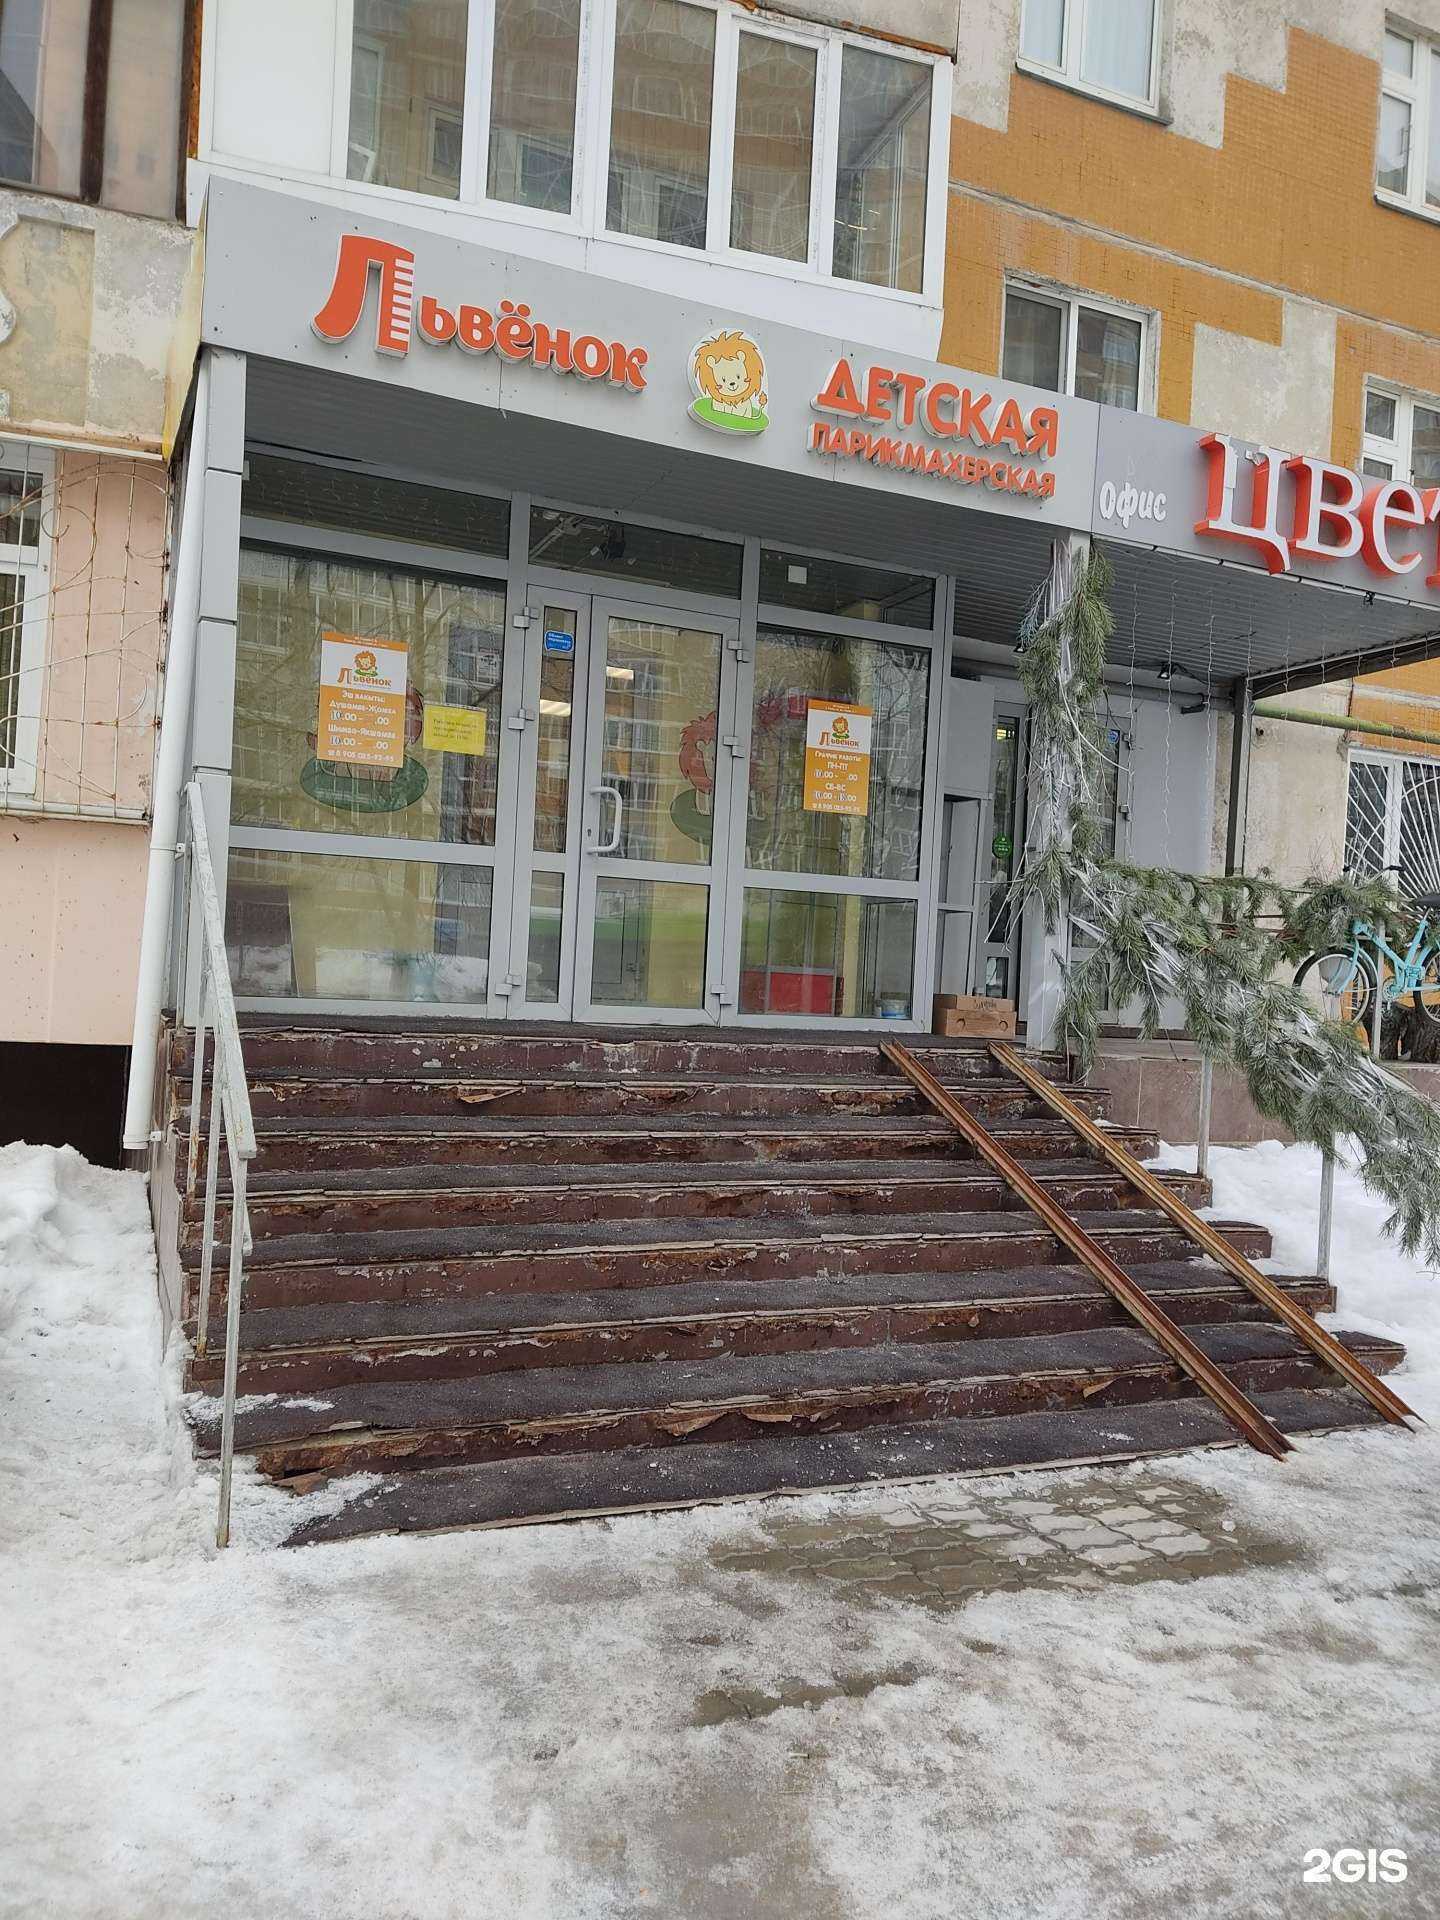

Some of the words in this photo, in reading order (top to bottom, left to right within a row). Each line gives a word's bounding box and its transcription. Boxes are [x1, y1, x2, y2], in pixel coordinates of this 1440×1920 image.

[312, 234, 649, 393] Львёнок
[812, 358, 1059, 460] ДЕТСКАЯ
[808, 422, 1055, 499] ПАРИКМАХЕРСКАЯ
[1099, 481, 1167, 529] Офис
